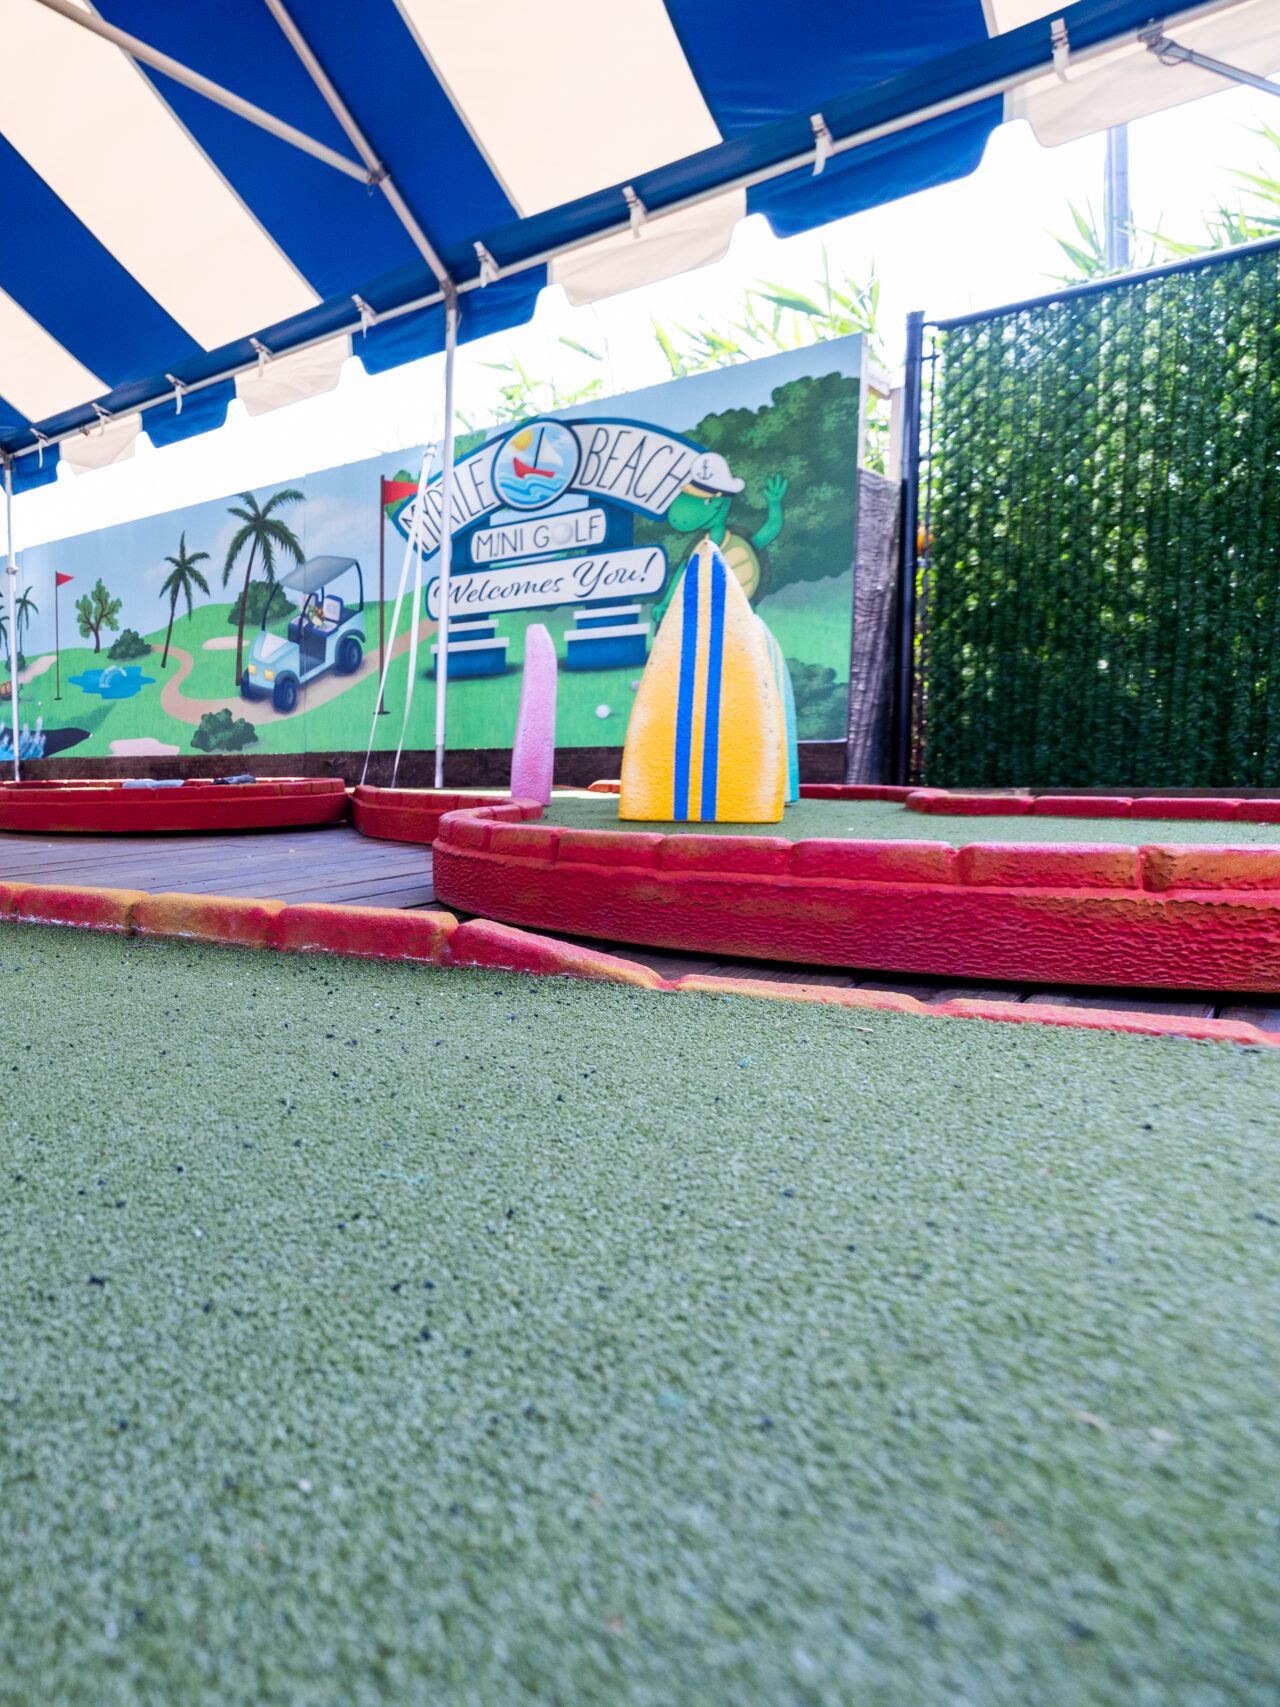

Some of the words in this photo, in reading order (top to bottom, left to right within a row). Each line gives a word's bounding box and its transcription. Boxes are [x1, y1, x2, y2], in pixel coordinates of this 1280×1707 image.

[578, 426, 692, 510] BEACH
[475, 528, 524, 560] MINI
[533, 514, 603, 549] GOLF
[433, 576, 566, 604] Welcomes
[572, 551, 659, 598] You!
